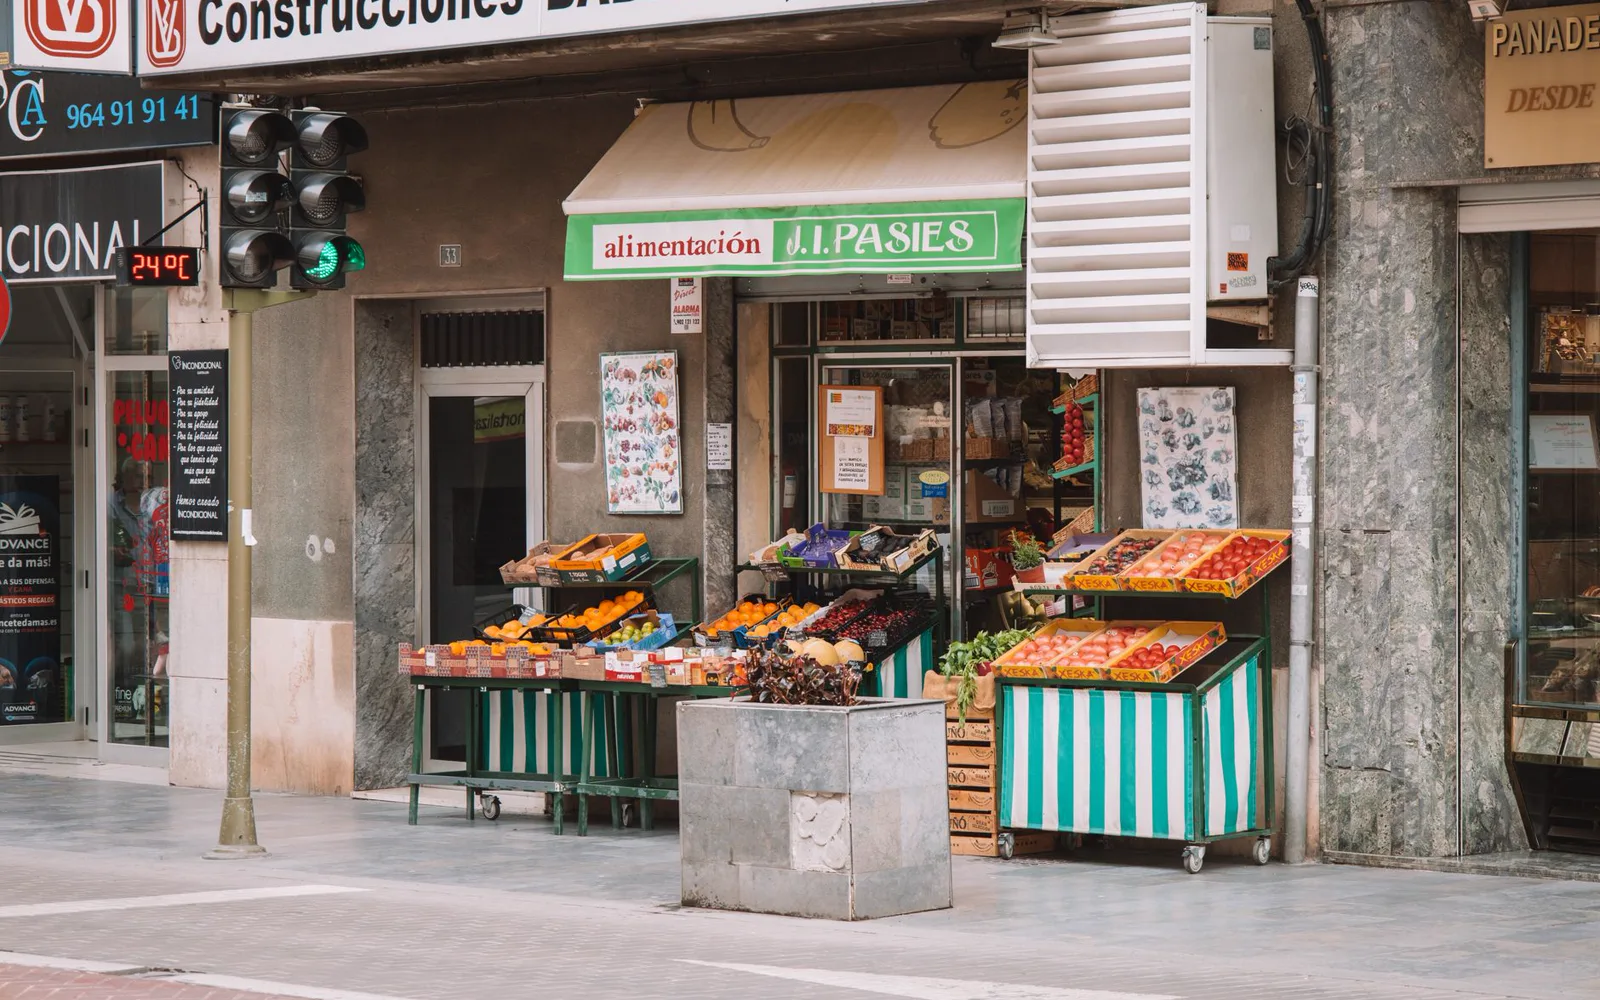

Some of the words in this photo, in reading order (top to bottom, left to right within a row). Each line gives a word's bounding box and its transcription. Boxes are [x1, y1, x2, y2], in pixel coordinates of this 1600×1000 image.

[1493, 15, 1600, 56] PANADE
[1505, 83, 1597, 113] DESDE
[66, 102, 105, 129] 964
[110, 99, 134, 126] 91
[142, 96, 166, 124] 91
[174, 94, 200, 120] 41
[604, 230, 762, 260] alimentación
[444, 247, 456, 264] 33
[673, 304, 700, 314] ALARMA
[181, 361, 222, 370] INCONDICIONAL
[176, 443, 186, 452] Por
[187, 443, 196, 452] los
[196, 446, 206, 454] que
[180, 456, 190, 465] que
[206, 454, 219, 465] algo
[195, 468, 204, 477] que
[189, 475, 211, 484] mascota
[175, 494, 196, 506] Hemos
[196, 496, 220, 507] creado
[177, 509, 218, 519] INCONDICIONAL
[8, 557, 22, 568] da
[25, 556, 51, 568] más!
[1254, 547, 1285, 574] XESKA
[1078, 578, 1112, 590] XESKA
[1132, 578, 1170, 591] XESKA
[1189, 581, 1225, 593] XESKA
[27, 596, 55, 604] REGALOS
[1180, 637, 1210, 664] XESKA
[1004, 667, 1040, 678] XESKA
[1059, 668, 1094, 679] XESKA
[1114, 671, 1150, 682] XESKA
[115, 686, 132, 700] fine
